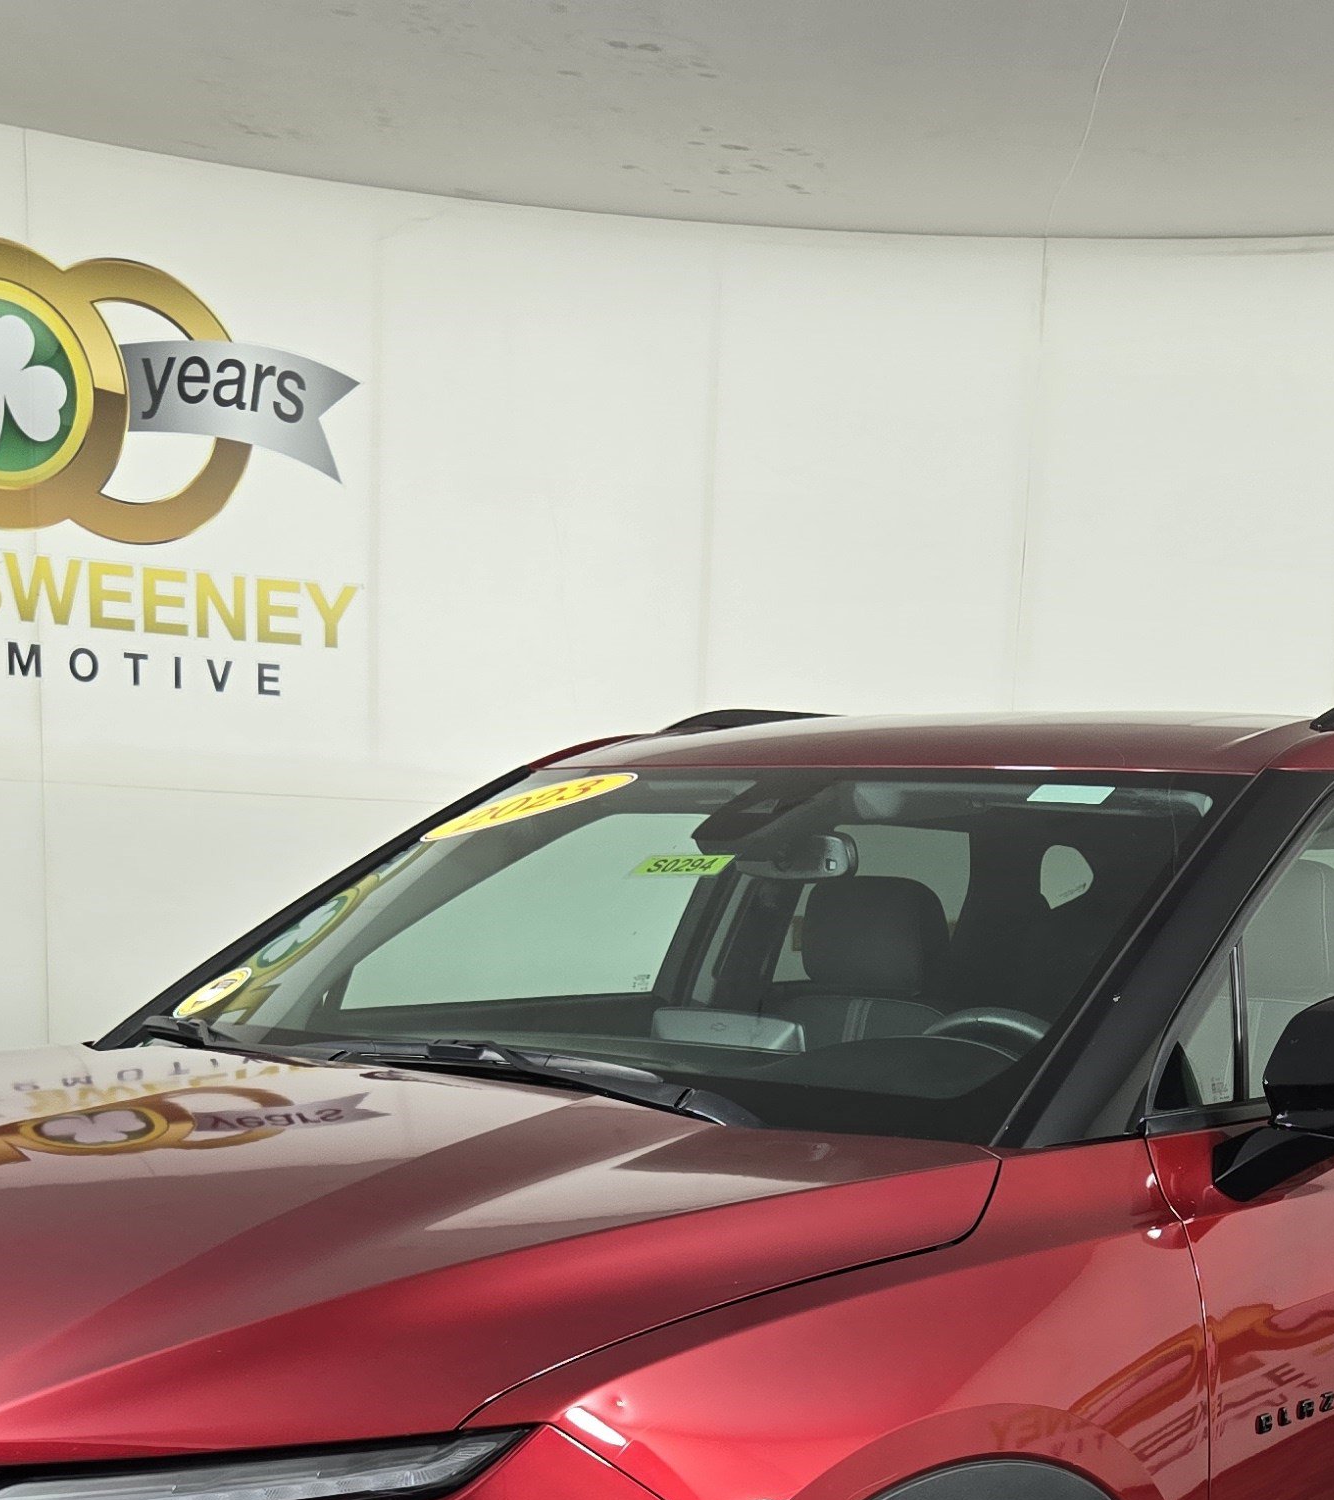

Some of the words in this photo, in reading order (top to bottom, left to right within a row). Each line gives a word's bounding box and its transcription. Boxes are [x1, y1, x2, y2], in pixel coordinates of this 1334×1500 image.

[139, 354, 308, 424] years
[452, 778, 606, 833] 2023
[646, 856, 719, 874] S0294
